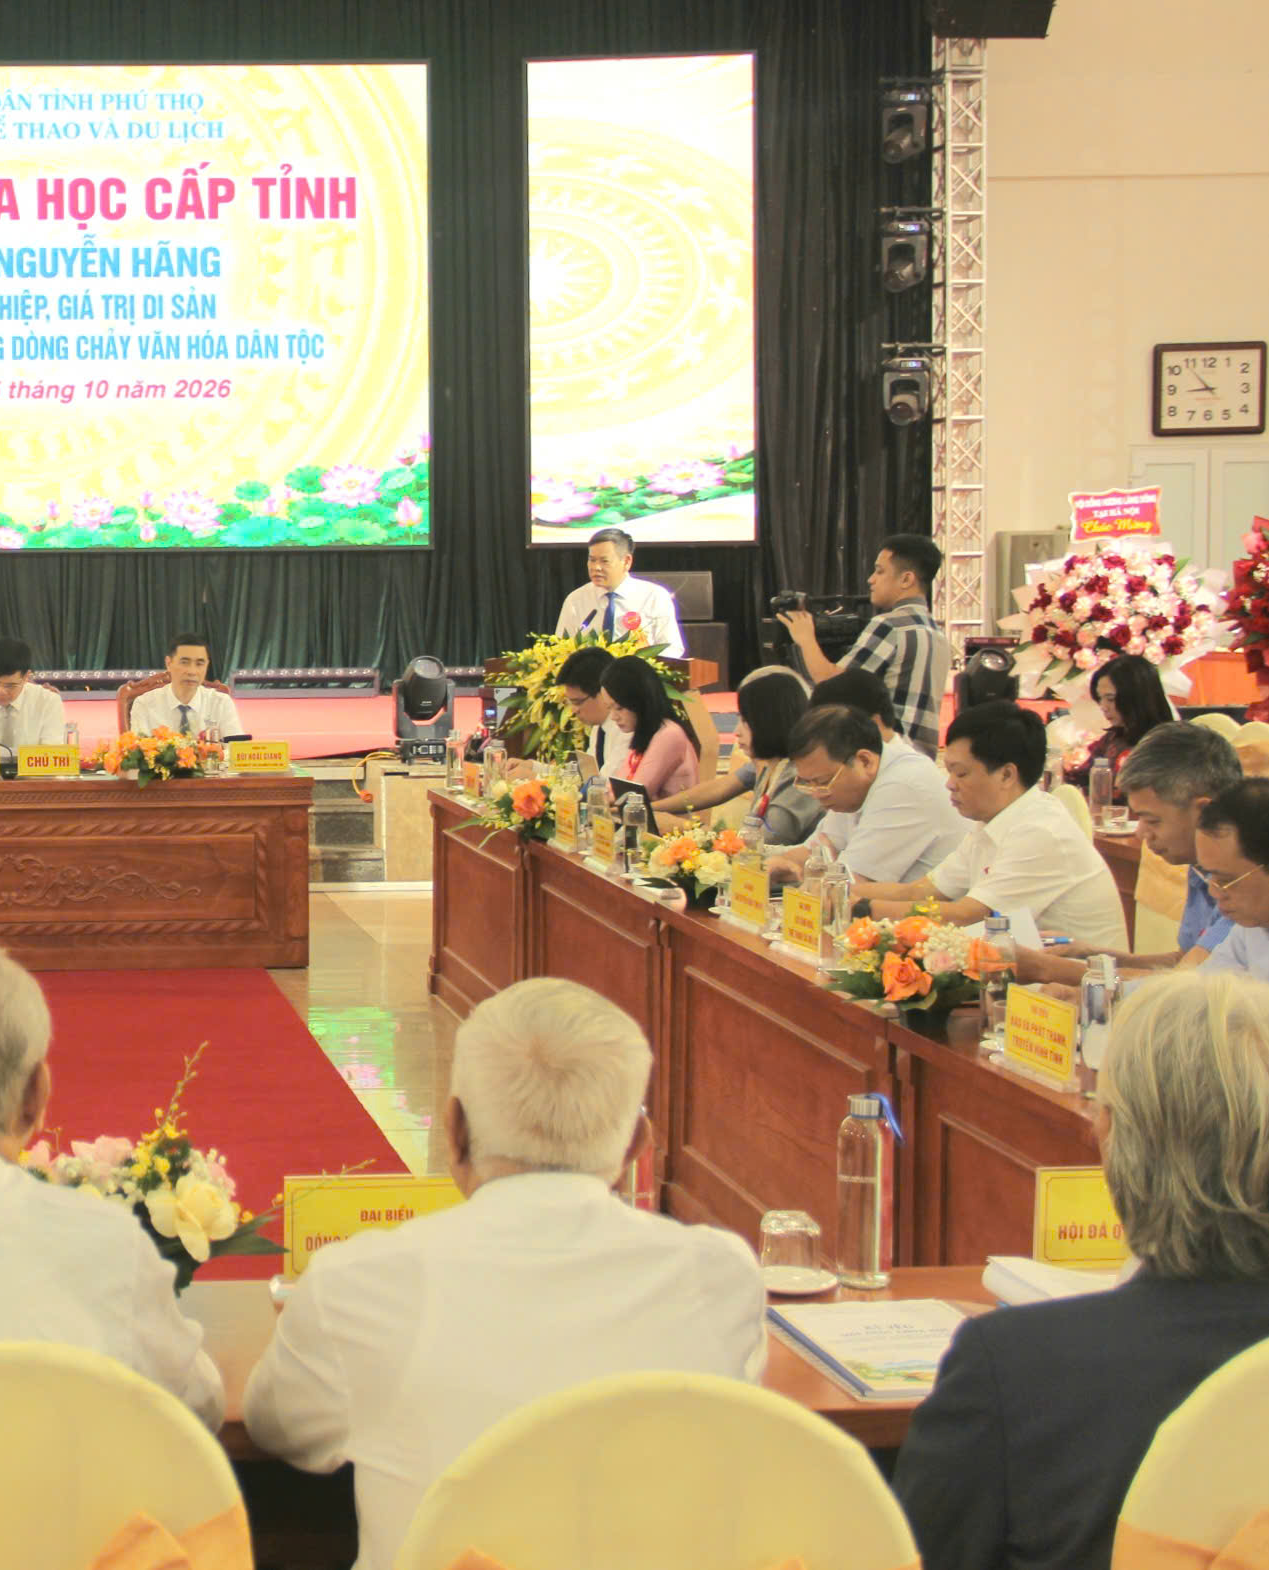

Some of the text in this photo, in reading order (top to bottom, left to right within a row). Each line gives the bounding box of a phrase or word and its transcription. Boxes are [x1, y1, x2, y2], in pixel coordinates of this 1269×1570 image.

[101, 89, 148, 111] PHÚ
[156, 93, 204, 115] THỌ
[14, 121, 81, 140] THAO
[88, 117, 120, 140] VÀ
[127, 122, 160, 140] DU
[168, 121, 224, 143] LỊCH
[36, 177, 127, 230] HỌC
[145, 161, 236, 220] CẤP
[252, 163, 357, 220] TỈNH
[132, 240, 221, 278] HÃNG
[58, 289, 94, 320] GIÁ
[101, 294, 135, 326] TRỊ
[143, 294, 164, 320] DI
[171, 286, 216, 320] SẢN
[12, 330, 69, 360] DÒNG
[76, 328, 131, 360] CHẢY
[138, 330, 181, 360] VĂN
[187, 330, 229, 360] HÓA
[236, 329, 279, 360] DÂN
[285, 329, 325, 364] TỘC
[1184, 358, 1196, 369] 11
[1202, 357, 1217, 368] 12
[1226, 357, 1231, 368] 1
[1239, 362, 1250, 374] 2
[1167, 365, 1181, 376] 10
[9, 380, 75, 404] tháng
[84, 380, 109, 399] 10
[116, 380, 166, 399] năm
[174, 379, 232, 398] 2026
[1167, 384, 1177, 395] 9
[1240, 382, 1251, 394] 3
[1167, 406, 1177, 417] 8
[1221, 409, 1231, 420] 5
[1239, 404, 1249, 414] 4
[1186, 410, 1196, 421] 7
[1203, 410, 1213, 421] 6
[26, 752, 49, 767] CHỦ
[1058, 1221, 1084, 1244] HỘI
